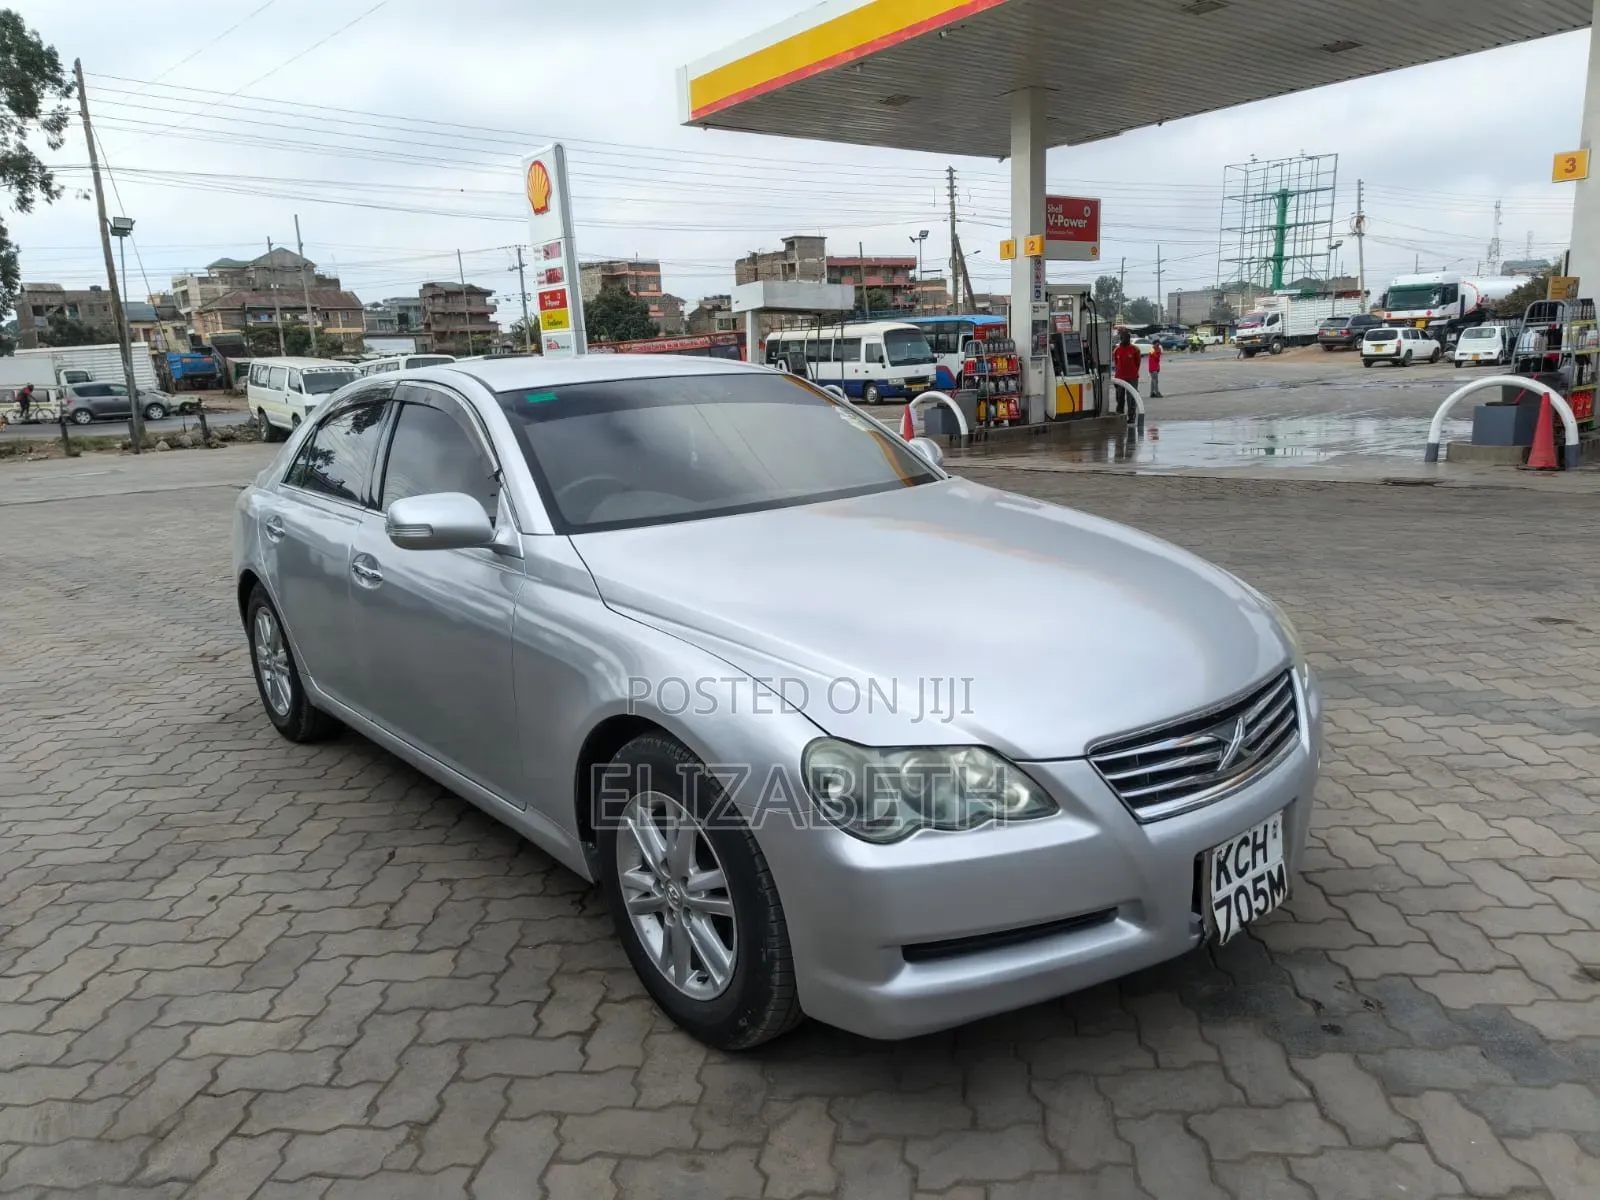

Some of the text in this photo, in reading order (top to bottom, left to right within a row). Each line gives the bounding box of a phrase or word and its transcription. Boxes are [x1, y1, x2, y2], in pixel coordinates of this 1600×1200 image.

[1564, 157, 1576, 173] 3
[1047, 204, 1063, 213] Shell
[1047, 214, 1088, 229] V-Power
[1005, 243, 1010, 254] 1
[1028, 241, 1035, 251] 2
[1215, 824, 1268, 892] KCH
[1214, 863, 1286, 942] 705M
